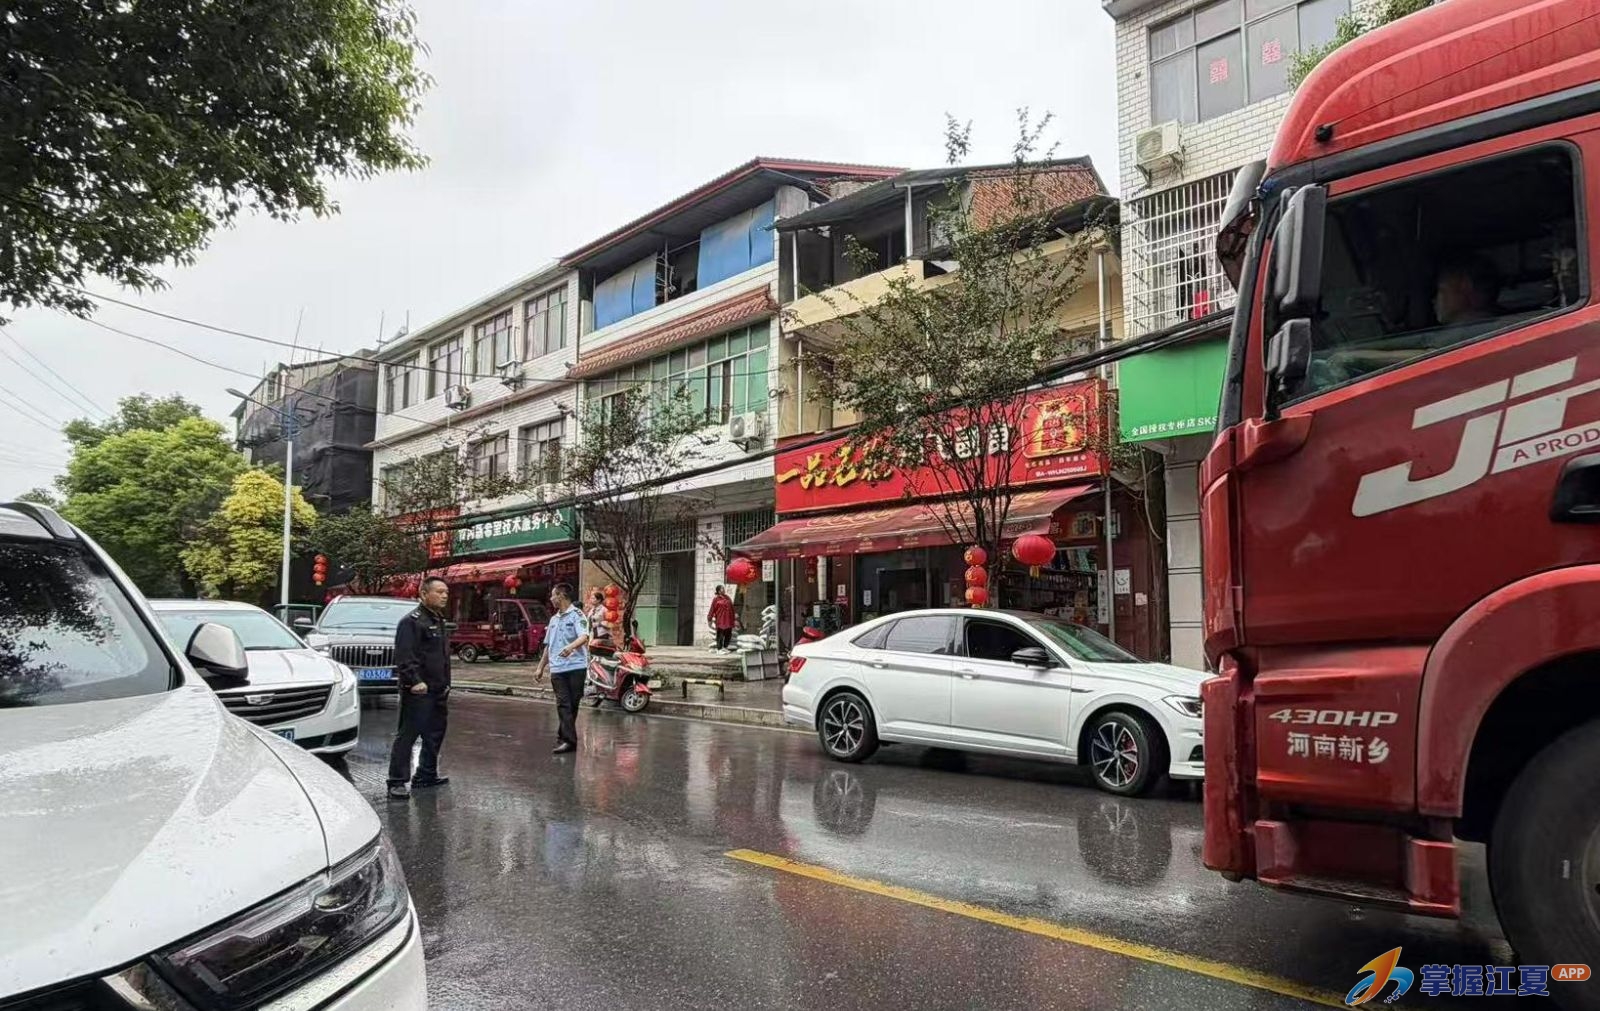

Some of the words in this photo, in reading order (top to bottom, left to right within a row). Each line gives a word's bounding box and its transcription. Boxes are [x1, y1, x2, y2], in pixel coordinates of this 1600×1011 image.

[1131, 418, 1196, 436] 全国授权专柜店
[1512, 448, 1529, 463] A
[1268, 708, 1398, 727] 430HP
[1287, 731, 1391, 765] 河南新乡
